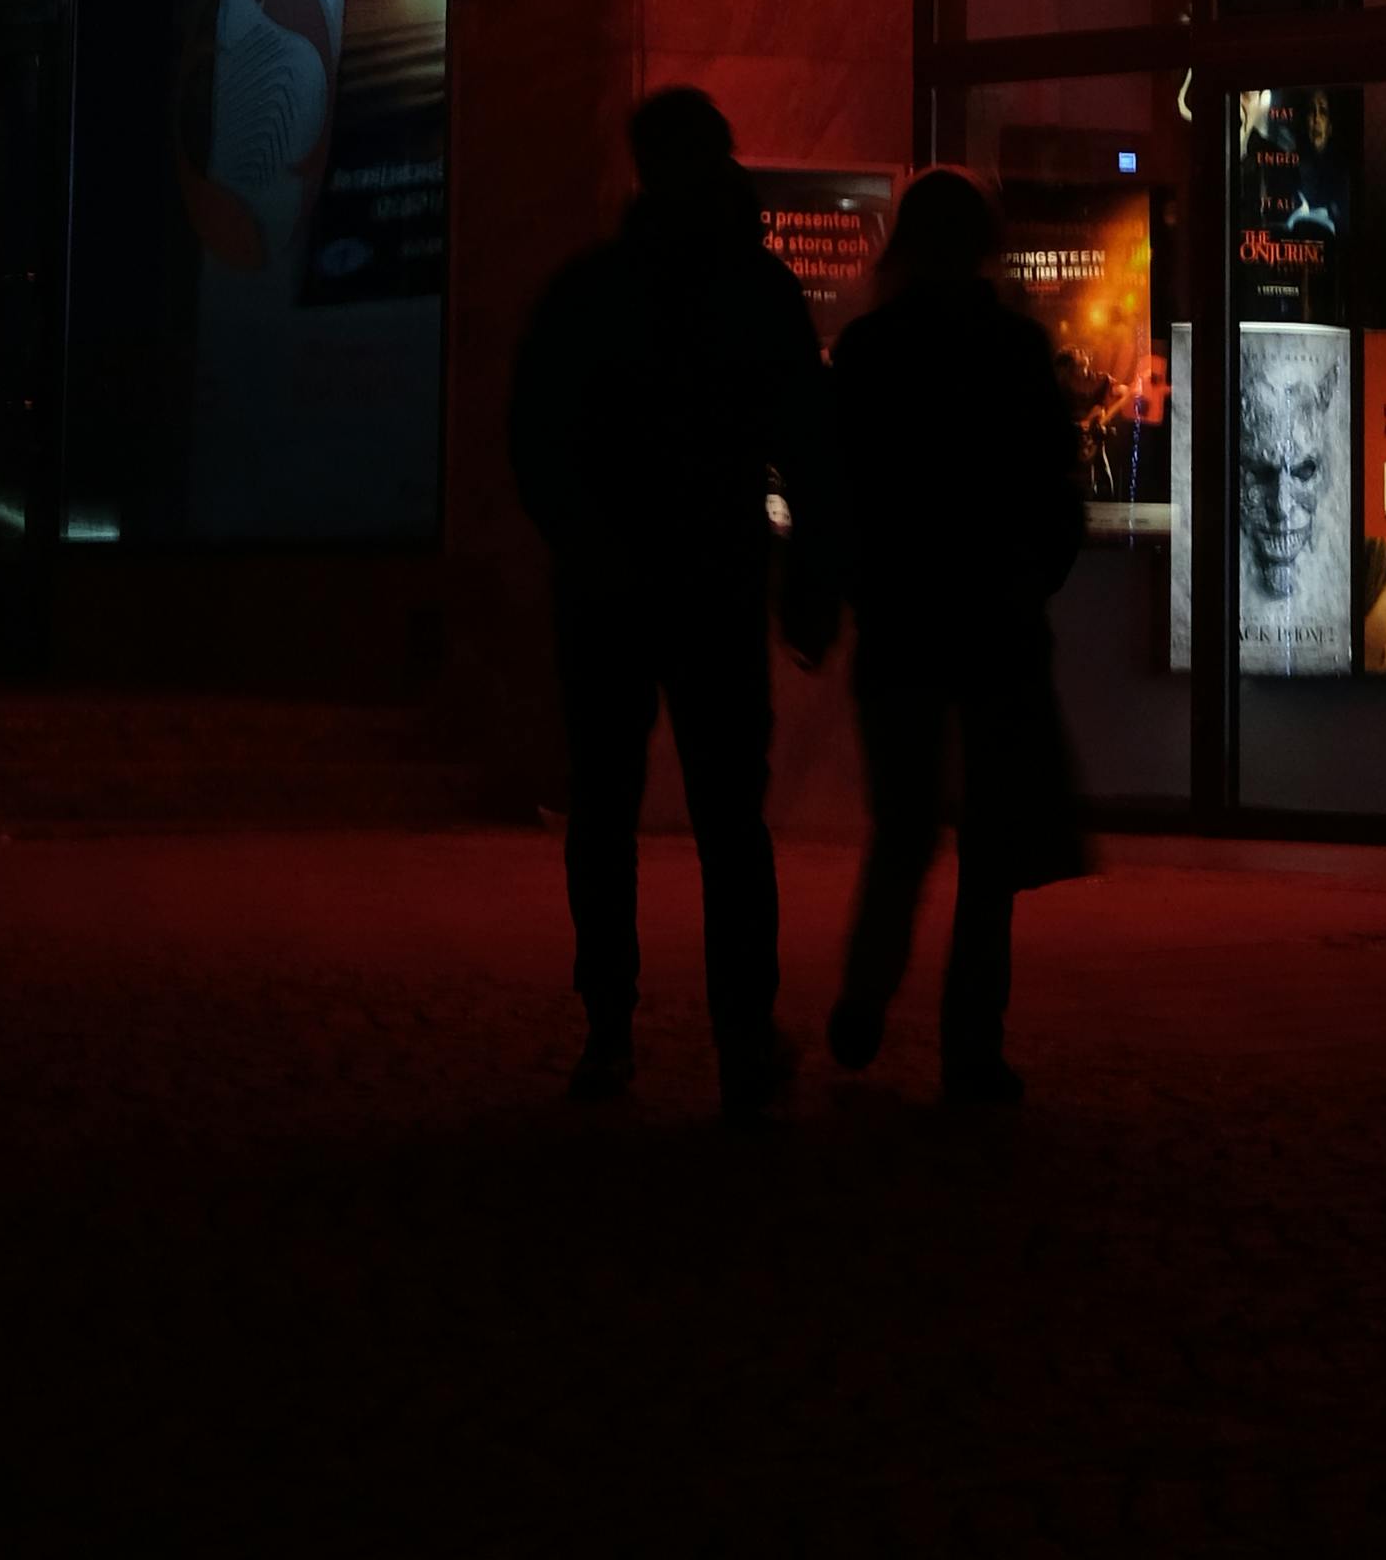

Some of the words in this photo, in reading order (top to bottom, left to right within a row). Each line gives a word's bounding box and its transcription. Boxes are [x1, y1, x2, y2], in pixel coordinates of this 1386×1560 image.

[776, 210, 861, 232] presenten
[788, 233, 833, 253] stora
[838, 234, 869, 256] och
[1238, 241, 1324, 266] ONJURING
